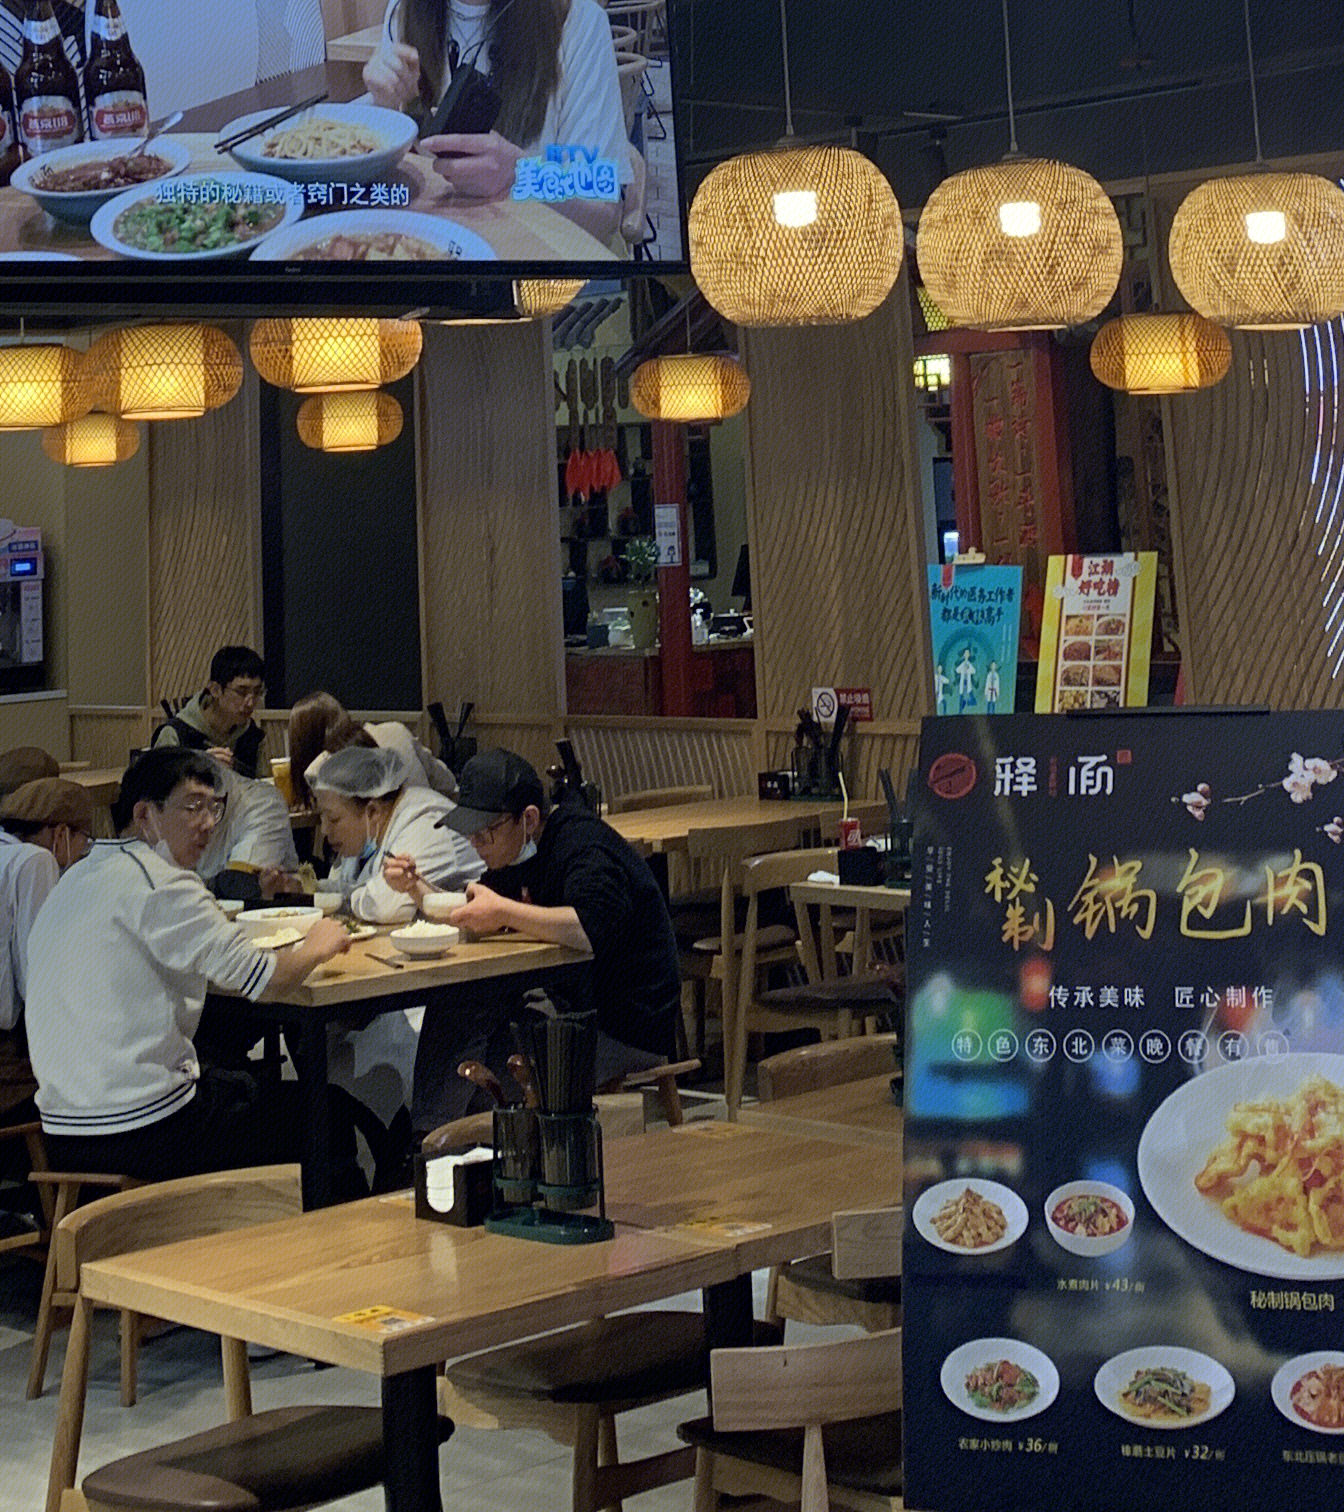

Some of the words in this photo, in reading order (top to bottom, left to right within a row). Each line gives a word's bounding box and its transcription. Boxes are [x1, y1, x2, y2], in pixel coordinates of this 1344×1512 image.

[513, 156, 619, 203] 美食地图
[155, 179, 410, 207] 独特的秘籍或者窍门之类的
[1049, 985, 1146, 1009] 传承美味
[1174, 985, 1273, 1009] 匠心制作
[1250, 1289, 1335, 1312] 秘制锅包肉
